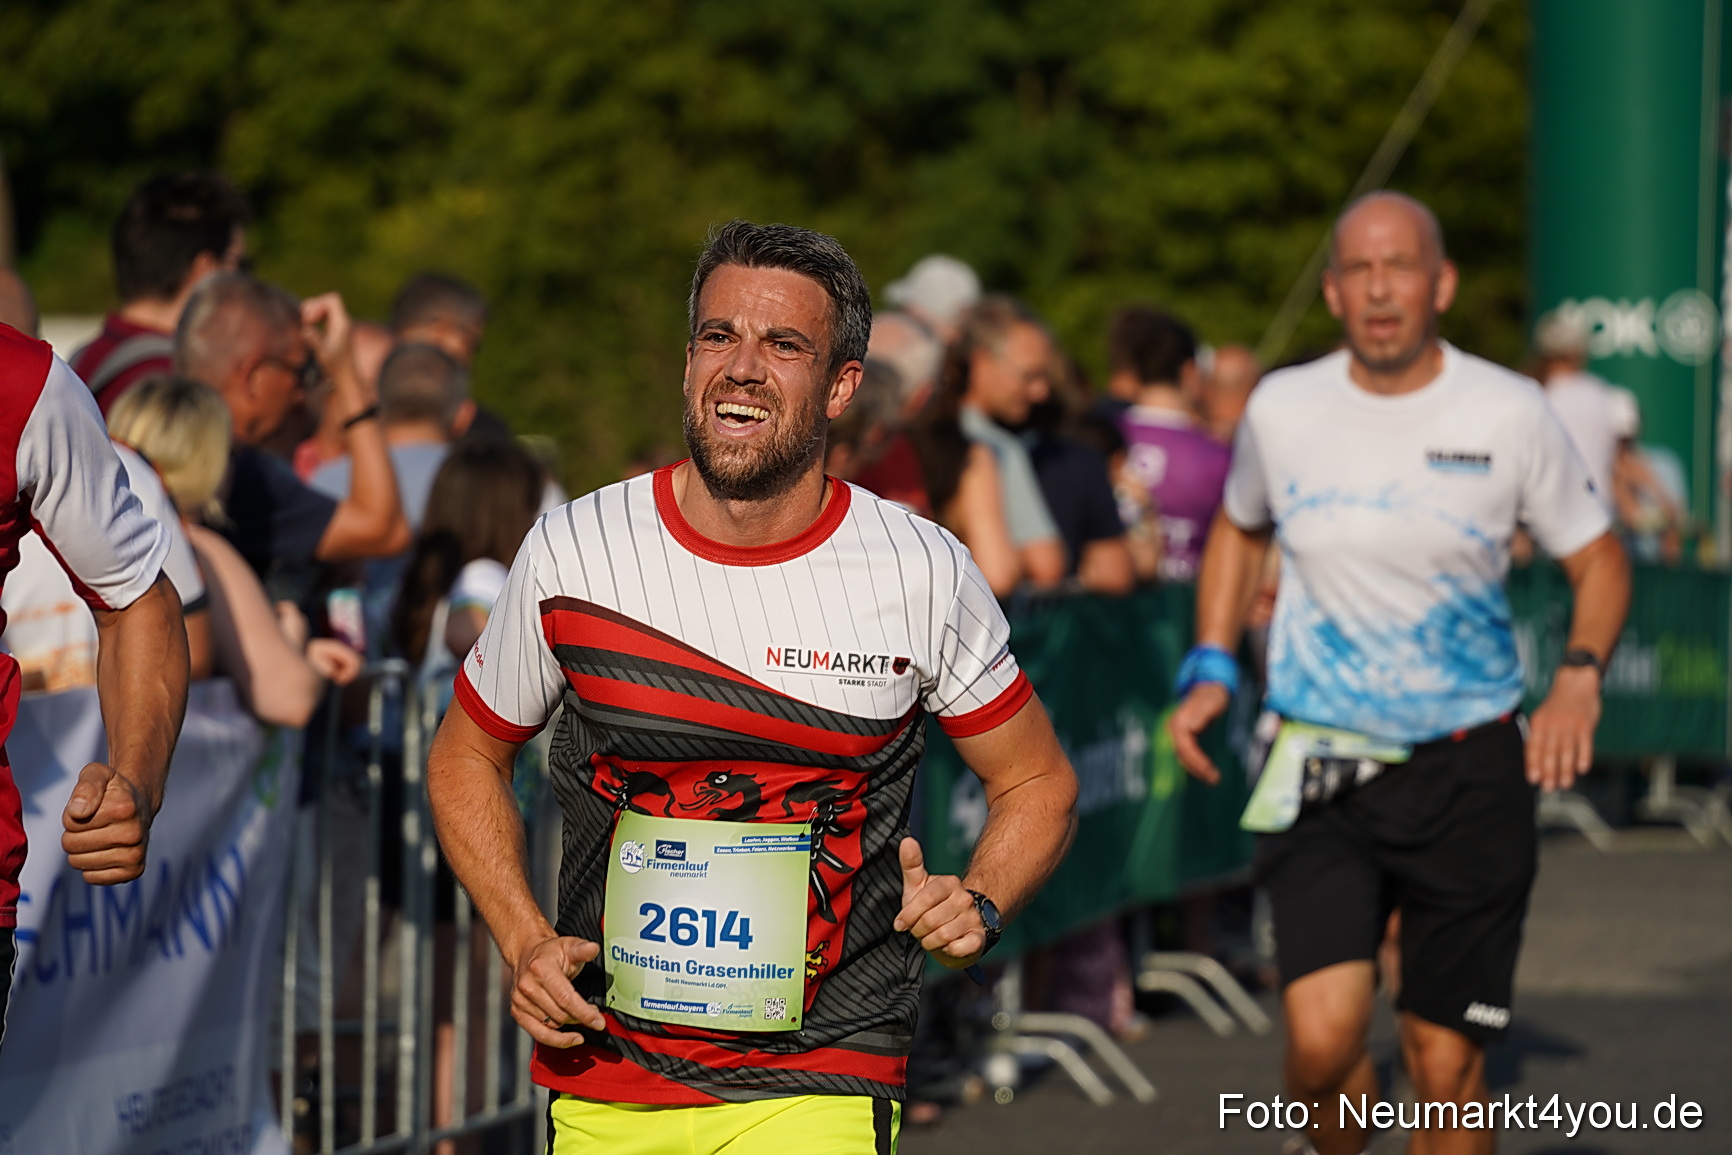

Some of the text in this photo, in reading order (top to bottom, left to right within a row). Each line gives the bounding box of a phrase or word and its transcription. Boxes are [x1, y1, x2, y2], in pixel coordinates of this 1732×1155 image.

[766, 646, 890, 675] NEUMARKT
[838, 678, 887, 688] STARKE STADT
[646, 859, 709, 872] Firmenlauf
[669, 871, 707, 879] neumarkt
[639, 902, 753, 950] 2614
[611, 945, 795, 979] Christian Grasenhiller
[665, 977, 680, 985] Stadt
[680, 979, 708, 988] Neumarkt
[643, 1000, 704, 1013] firmenlauf.bayern
